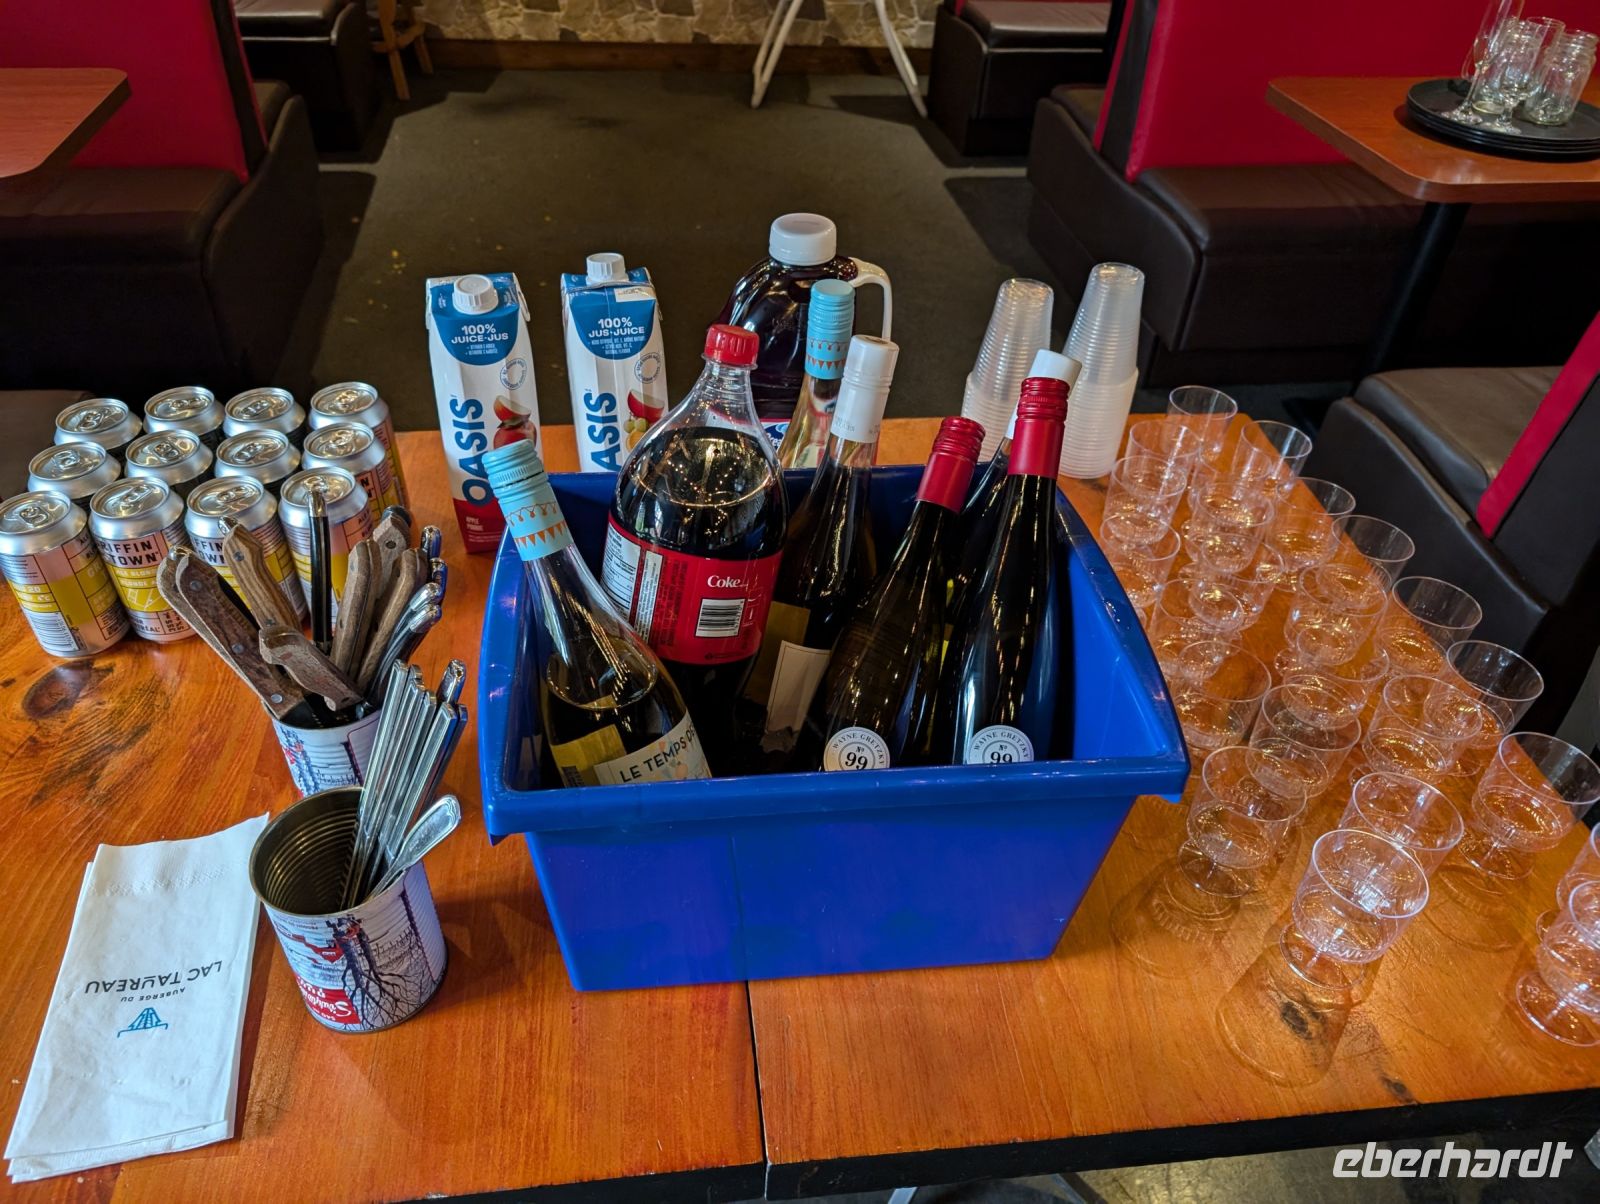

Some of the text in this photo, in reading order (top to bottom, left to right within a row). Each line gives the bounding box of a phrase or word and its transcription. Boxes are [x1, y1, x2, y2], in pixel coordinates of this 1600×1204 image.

[462, 323, 496, 335] 100%
[598, 316, 632, 329] 100%
[584, 392, 622, 472] ASIS
[449, 398, 496, 507] OASIS
[100, 541, 152, 554] RIFFIN
[707, 575, 741, 588] Coke
[832, 732, 885, 764] WAYNE GRETZKY
[974, 731, 1029, 758] WAYNE GRETZKY
[620, 765, 641, 783] LE
[643, 737, 687, 771] TEMPS
[845, 752, 868, 770] 99
[85, 960, 223, 994] LAC TAUREAU
[138, 987, 186, 1002] AUBERGE
